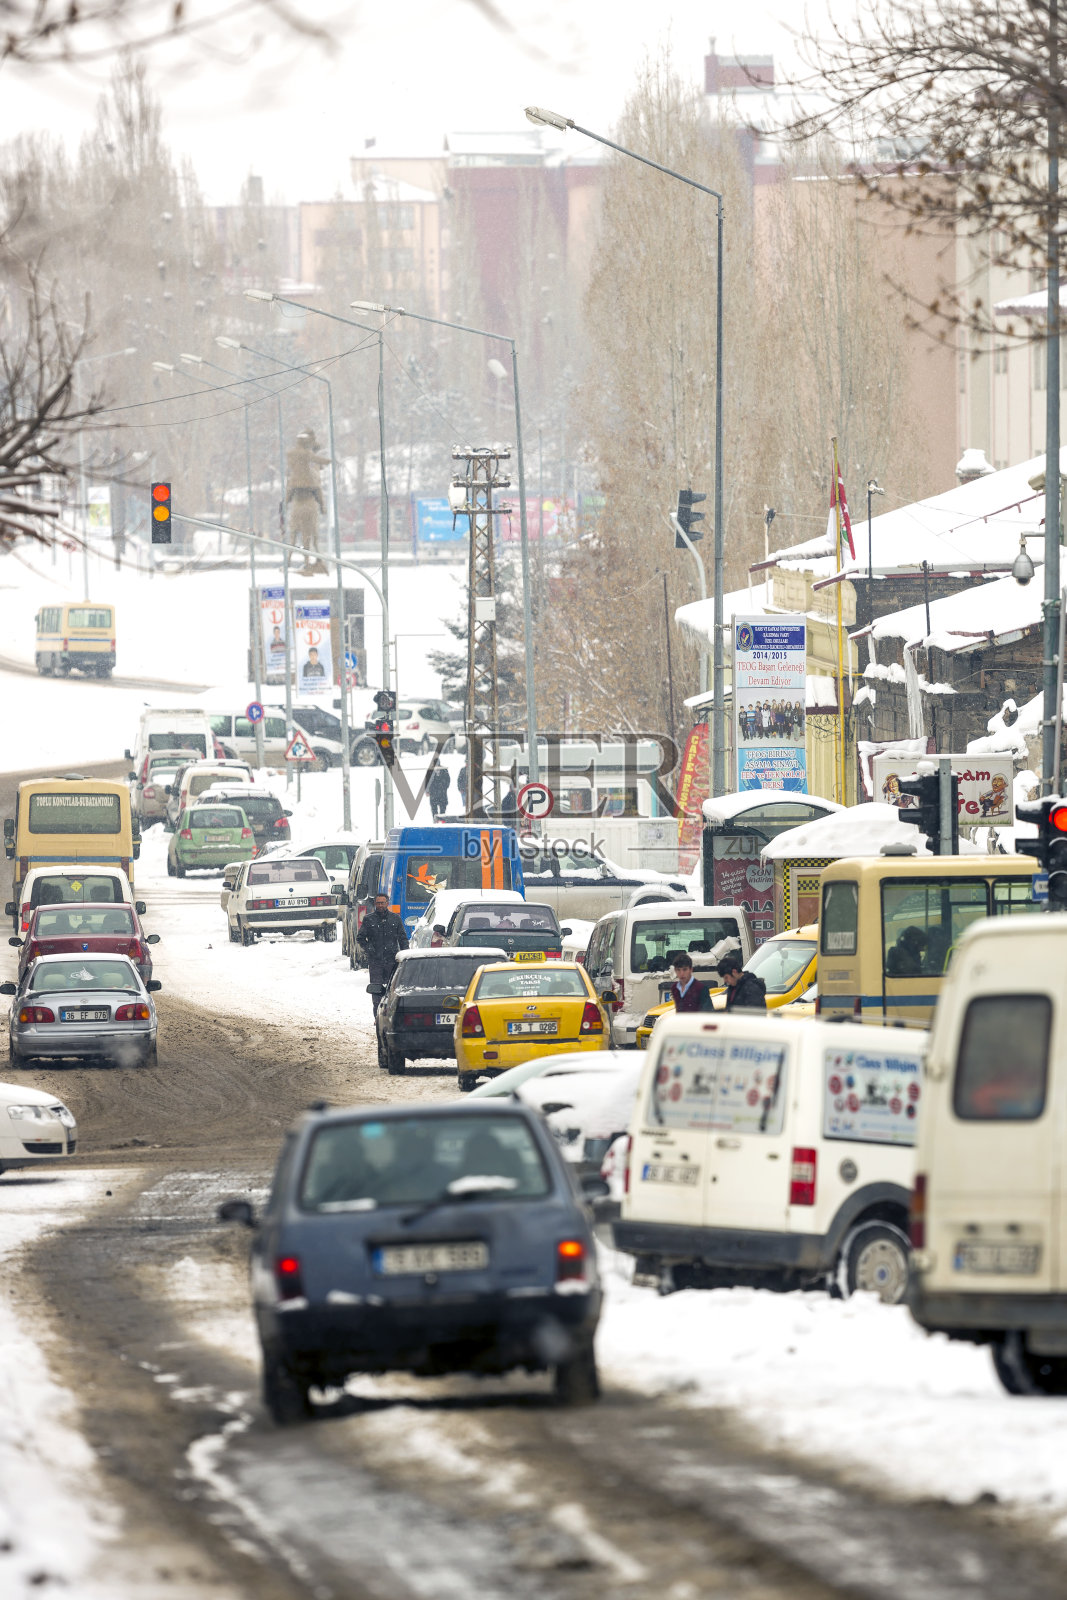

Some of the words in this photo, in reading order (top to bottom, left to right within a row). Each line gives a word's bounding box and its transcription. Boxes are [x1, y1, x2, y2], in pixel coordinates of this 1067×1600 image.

[753, 652, 788, 661] 2014/2015
[737, 662, 757, 671] TEOG
[777, 661, 805, 674] Geleneği
[748, 675, 769, 686] Devam
[771, 675, 792, 688] Ediyor
[686, 735, 699, 772] CAFE
[741, 771, 756, 779] FEN
[527, 791, 547, 813] P
[751, 869, 772, 877] SON
[66, 1012, 75, 1020] 36
[80, 1012, 89, 1020] EF
[440, 1015, 452, 1023] 76
[528, 1023, 533, 1032] T
